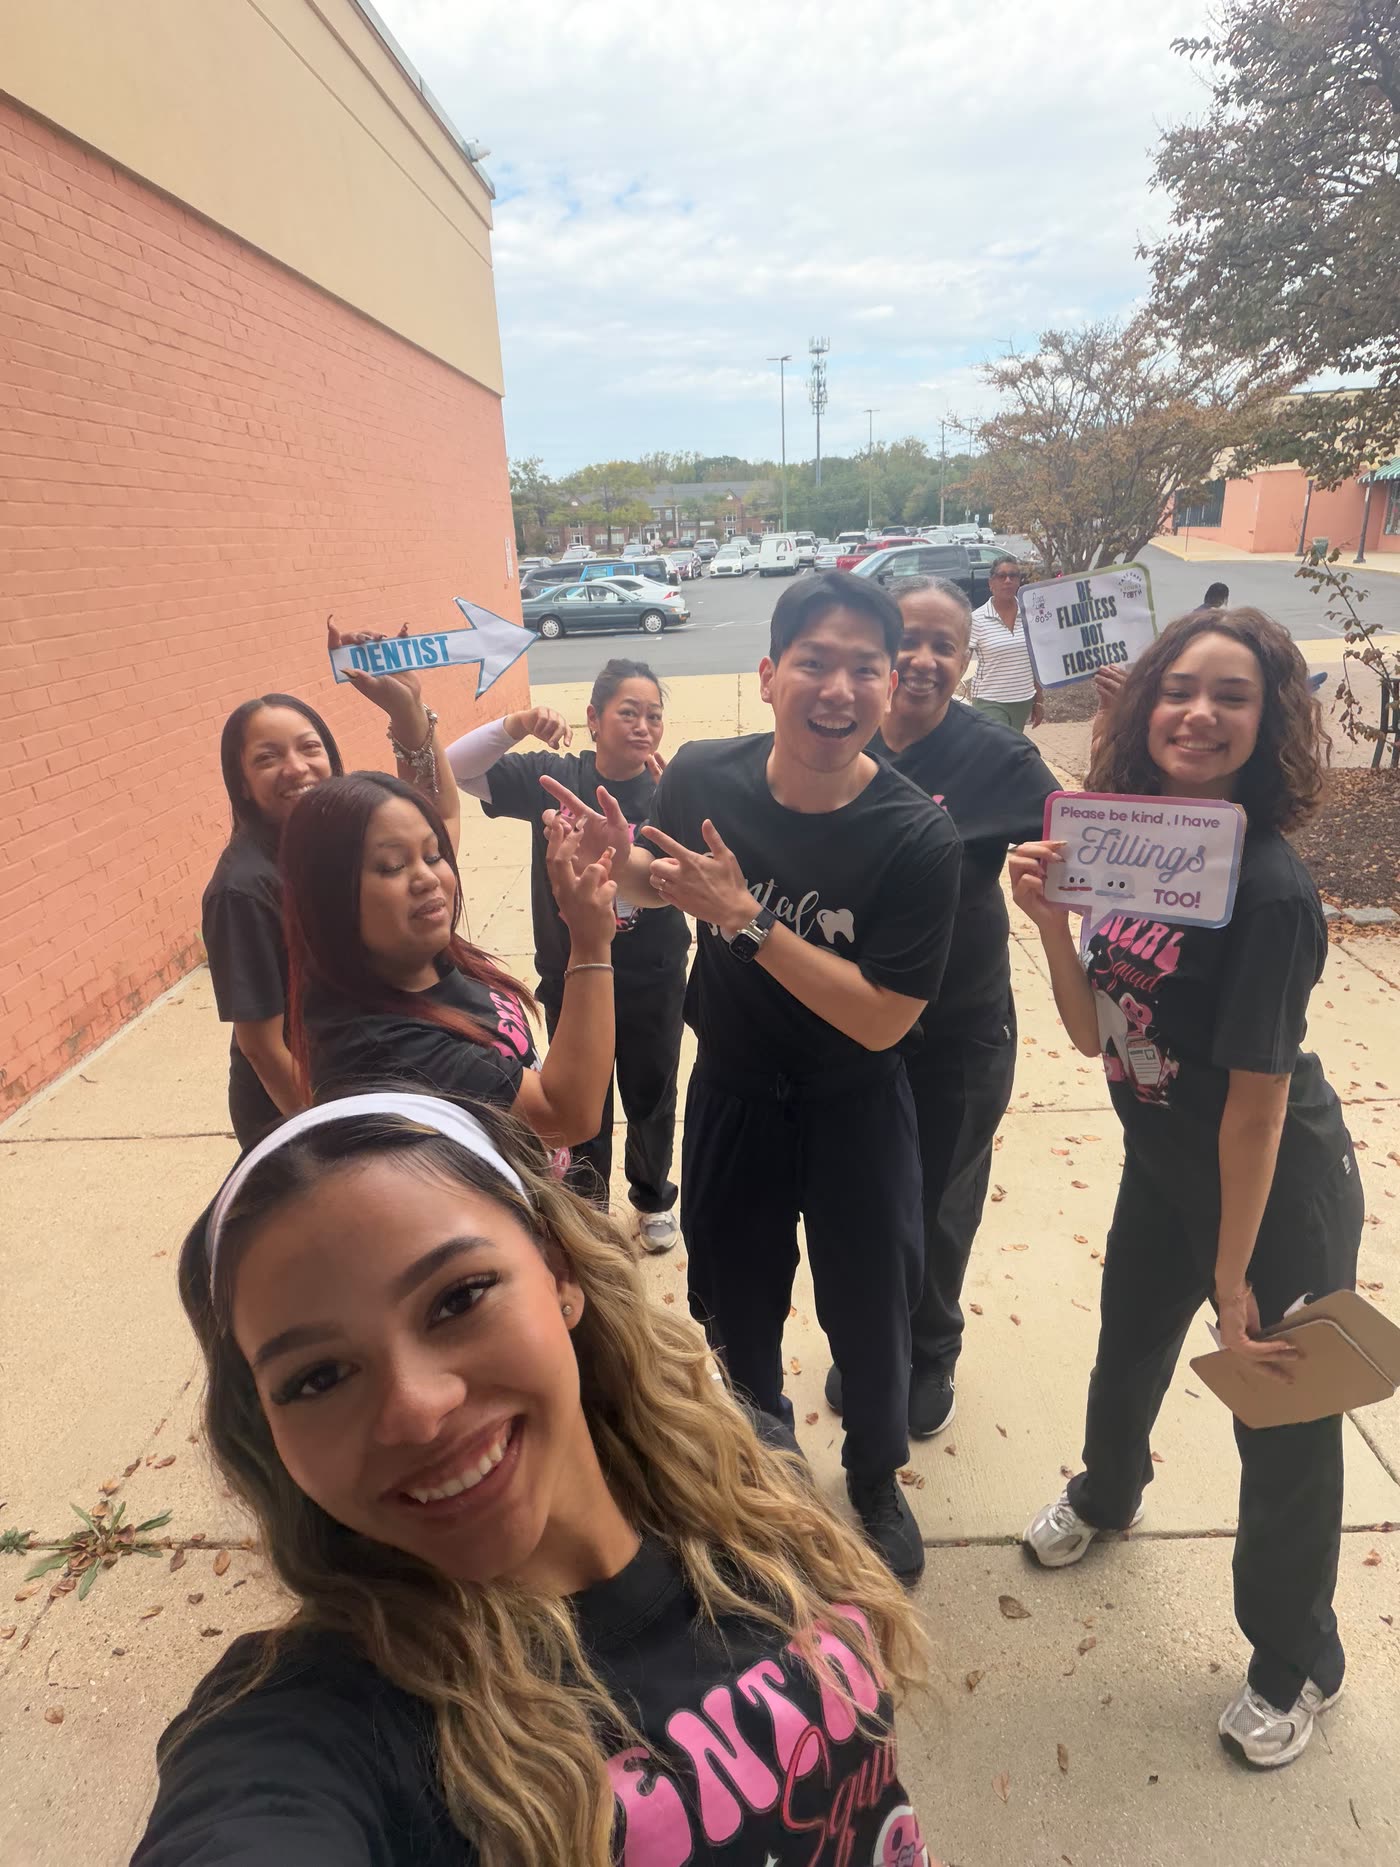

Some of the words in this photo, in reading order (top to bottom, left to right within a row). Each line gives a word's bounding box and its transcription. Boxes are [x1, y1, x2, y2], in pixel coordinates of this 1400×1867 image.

[1076, 579, 1093, 602] BE
[1056, 595, 1117, 629] FLAWLESS
[1080, 622, 1105, 648] NOT
[350, 635, 450, 673] DENTIST
[1062, 640, 1128, 676] FLOSSLESS
[1060, 806, 1105, 820] Please
[1109, 808, 1128, 821] be
[1174, 814, 1179, 825] I
[1182, 815, 1220, 828] have
[1077, 826, 1206, 884] Fillings
[1153, 888, 1201, 909] TOO!
[1098, 915, 1185, 972] NTAL
[606, 1603, 886, 1867] ENTA
